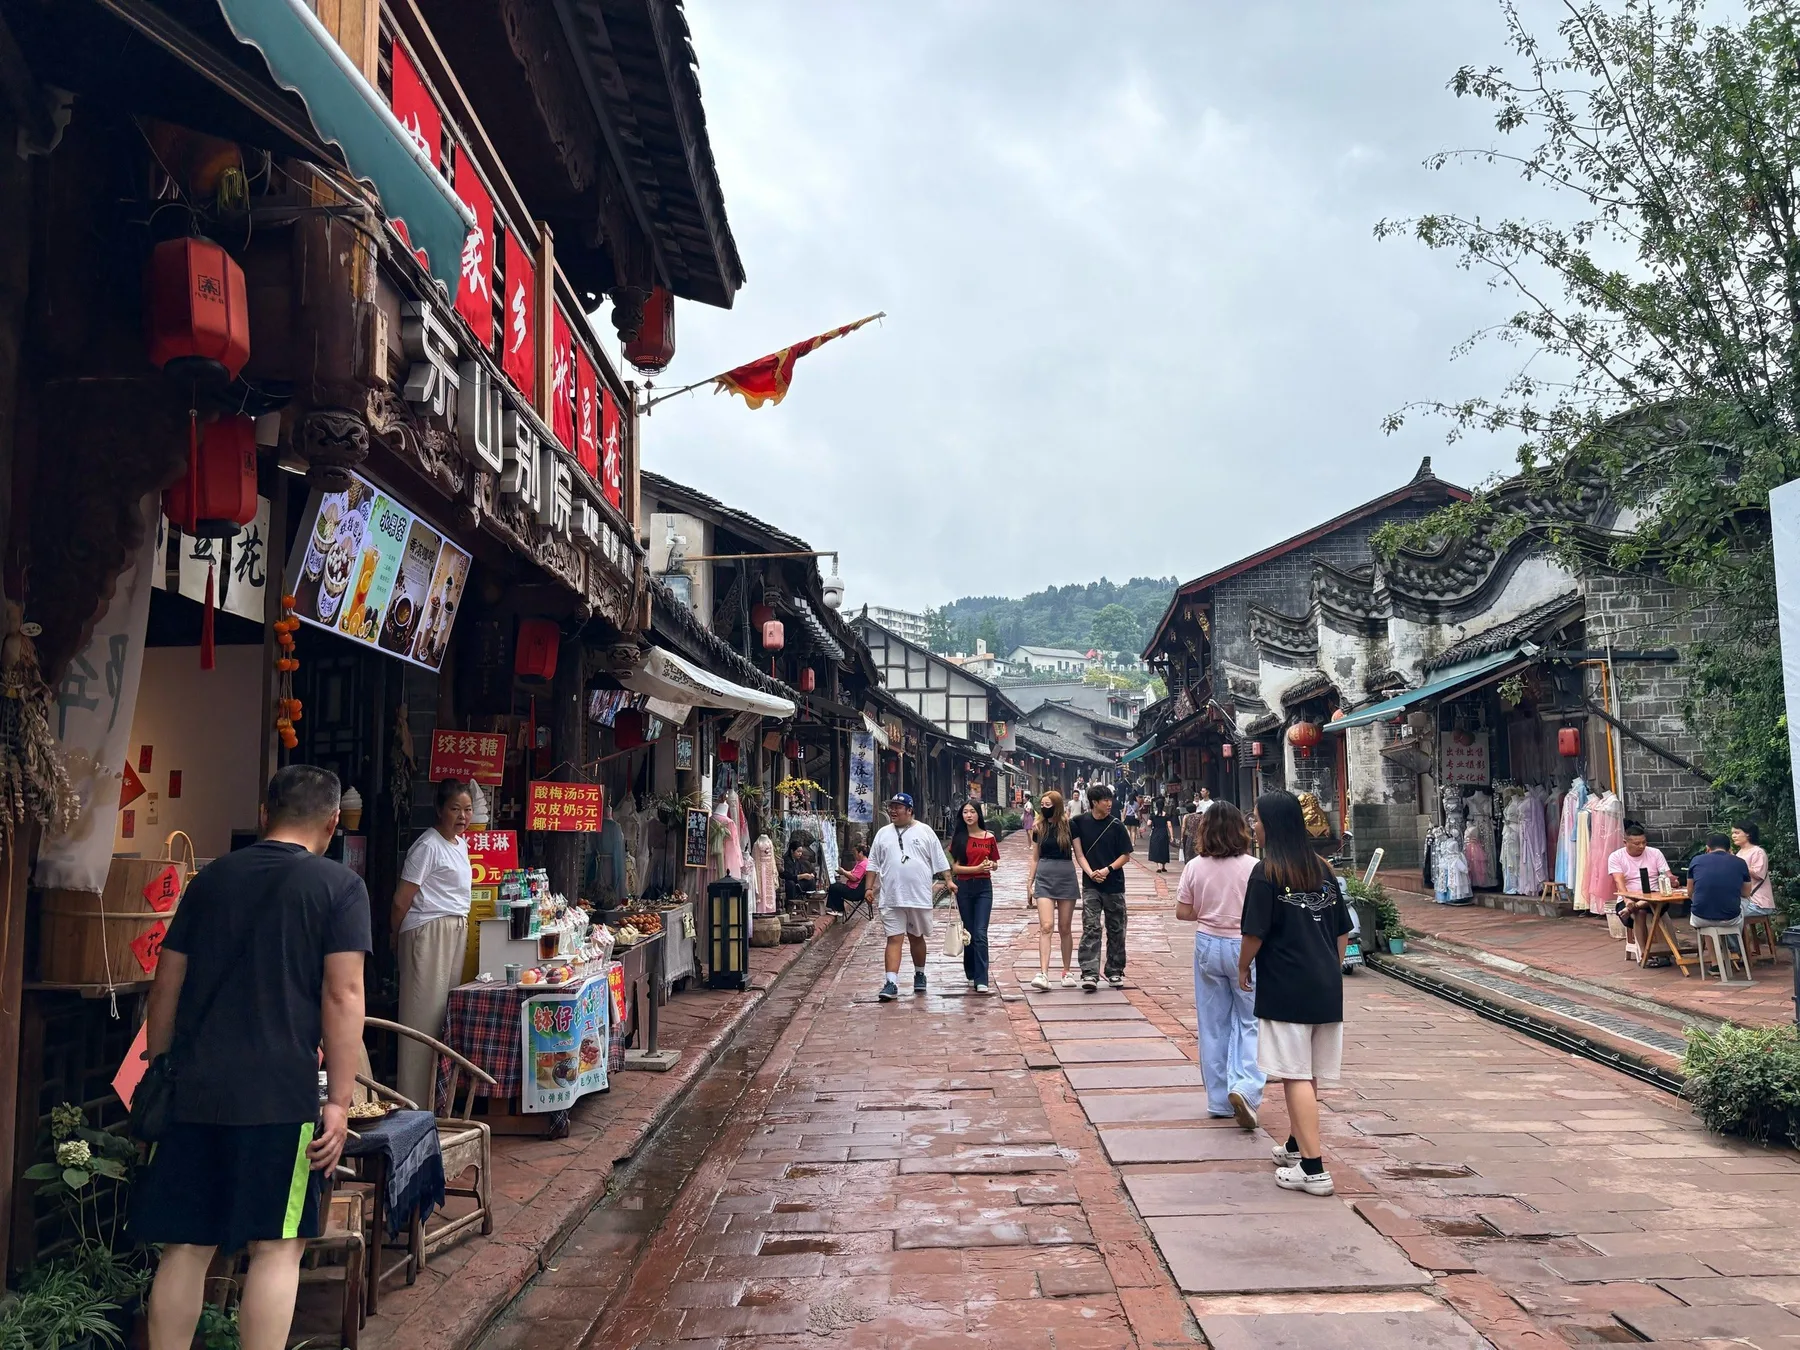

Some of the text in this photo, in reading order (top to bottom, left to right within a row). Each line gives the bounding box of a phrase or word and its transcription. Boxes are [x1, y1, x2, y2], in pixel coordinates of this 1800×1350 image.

[380, 509, 407, 543] 水果茶
[437, 734, 499, 757] 绞绞糖
[1446, 760, 1486, 770] 专业摄影
[1446, 772, 1486, 783] 专业化妆
[534, 785, 599, 801] 酸梅汤5元
[533, 802, 598, 818] 双皮奶5元
[532, 817, 597, 832] 椰汁 5元
